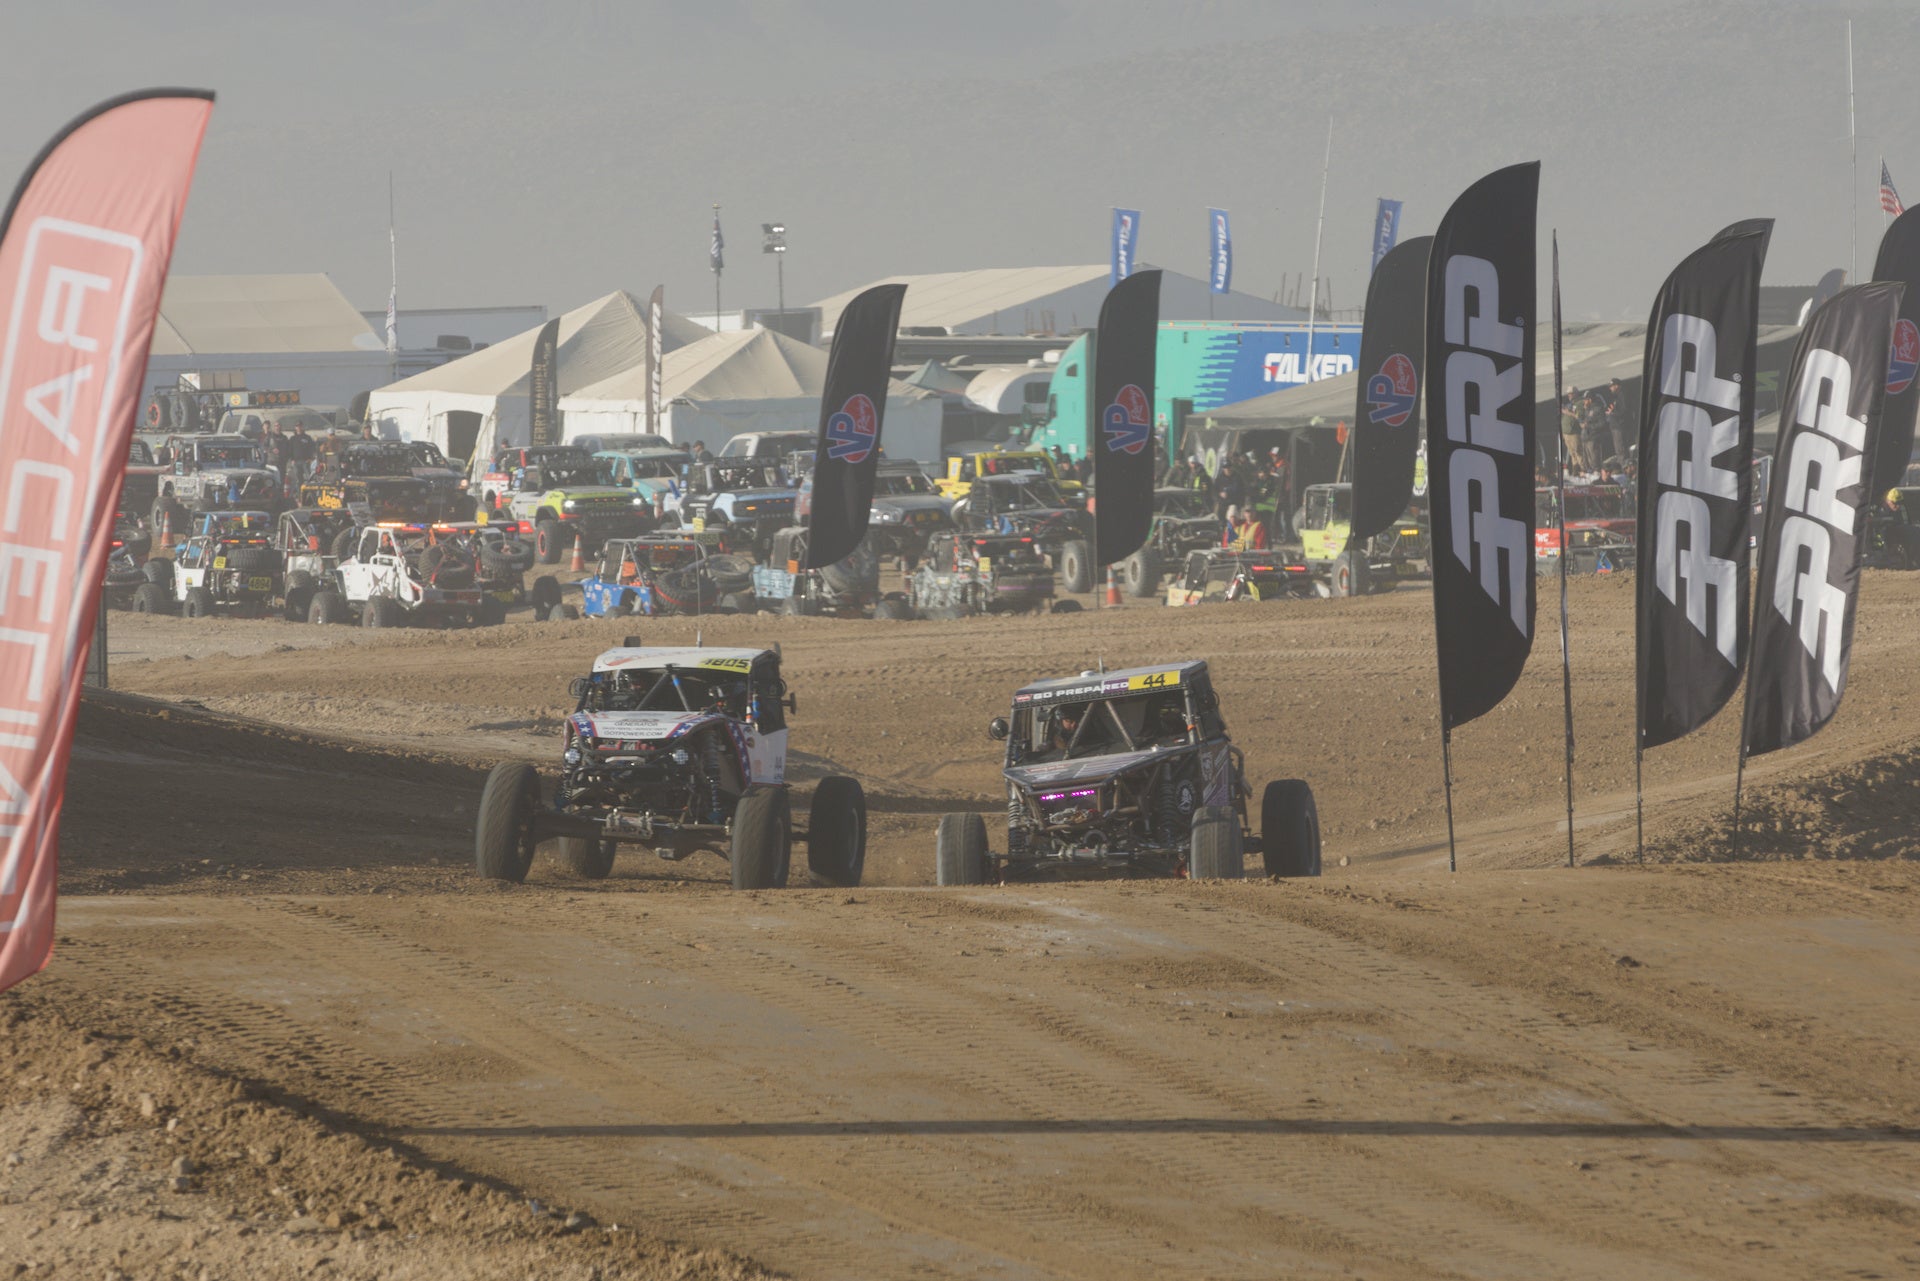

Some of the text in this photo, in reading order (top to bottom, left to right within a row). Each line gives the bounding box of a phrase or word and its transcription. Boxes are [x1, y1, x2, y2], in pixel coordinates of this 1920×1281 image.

[1215, 215, 1228, 289] FALKEN
[1264, 353, 1354, 383] FALKEN
[1366, 374, 1416, 423] VP
[826, 412, 876, 459] VP
[1103, 403, 1149, 452] VP
[1445, 254, 1527, 639] PRP
[1656, 313, 1742, 668] PRP
[1774, 348, 1868, 694] PRP
[1056, 682, 1130, 697] PREPARED
[1142, 674, 1165, 687] 44
